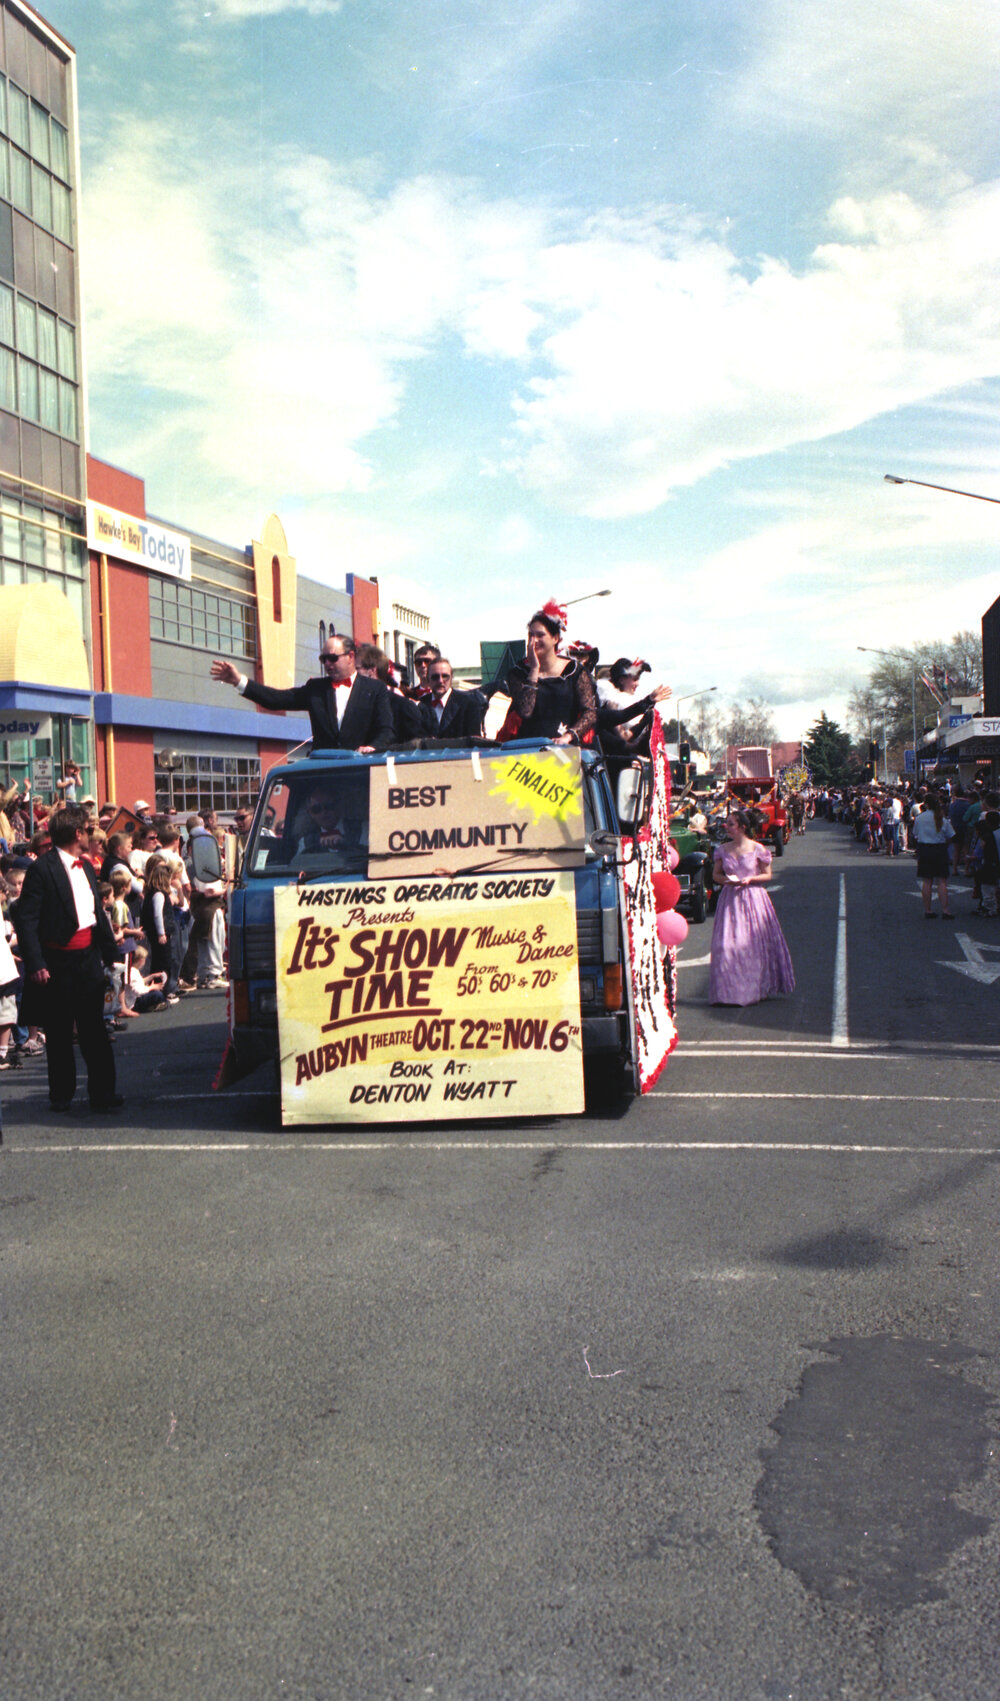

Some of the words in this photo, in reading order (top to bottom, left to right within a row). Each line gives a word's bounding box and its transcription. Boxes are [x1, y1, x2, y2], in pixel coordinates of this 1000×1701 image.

[98, 515, 126, 542] Hawke's
[128, 527, 140, 551] Bay
[138, 525, 184, 575] Today
[388, 785, 451, 809] BEST
[507, 761, 573, 807] FINALIST
[388, 823, 528, 851] COMMUNITY
[298, 886, 387, 906] HASTINGS
[393, 882, 478, 902] OPERATIC
[482, 879, 555, 899] SOCIETY
[342, 907, 415, 928] Presents
[286, 917, 340, 975] It's
[343, 927, 470, 978] SHOW
[471, 926, 527, 949] Music
[532, 924, 547, 943] &
[516, 942, 574, 964] Dance
[464, 963, 499, 975] From
[517, 977, 528, 988] &
[531, 969, 558, 989] 70's
[324, 970, 433, 1021] TIME
[295, 1033, 368, 1086] AUBYN
[370, 1030, 413, 1050] THEATRE
[412, 1018, 455, 1052] OCT.
[549, 1019, 580, 1052] 6TH
[349, 1083, 432, 1104] DENTON
[443, 1080, 518, 1101] WYATT
